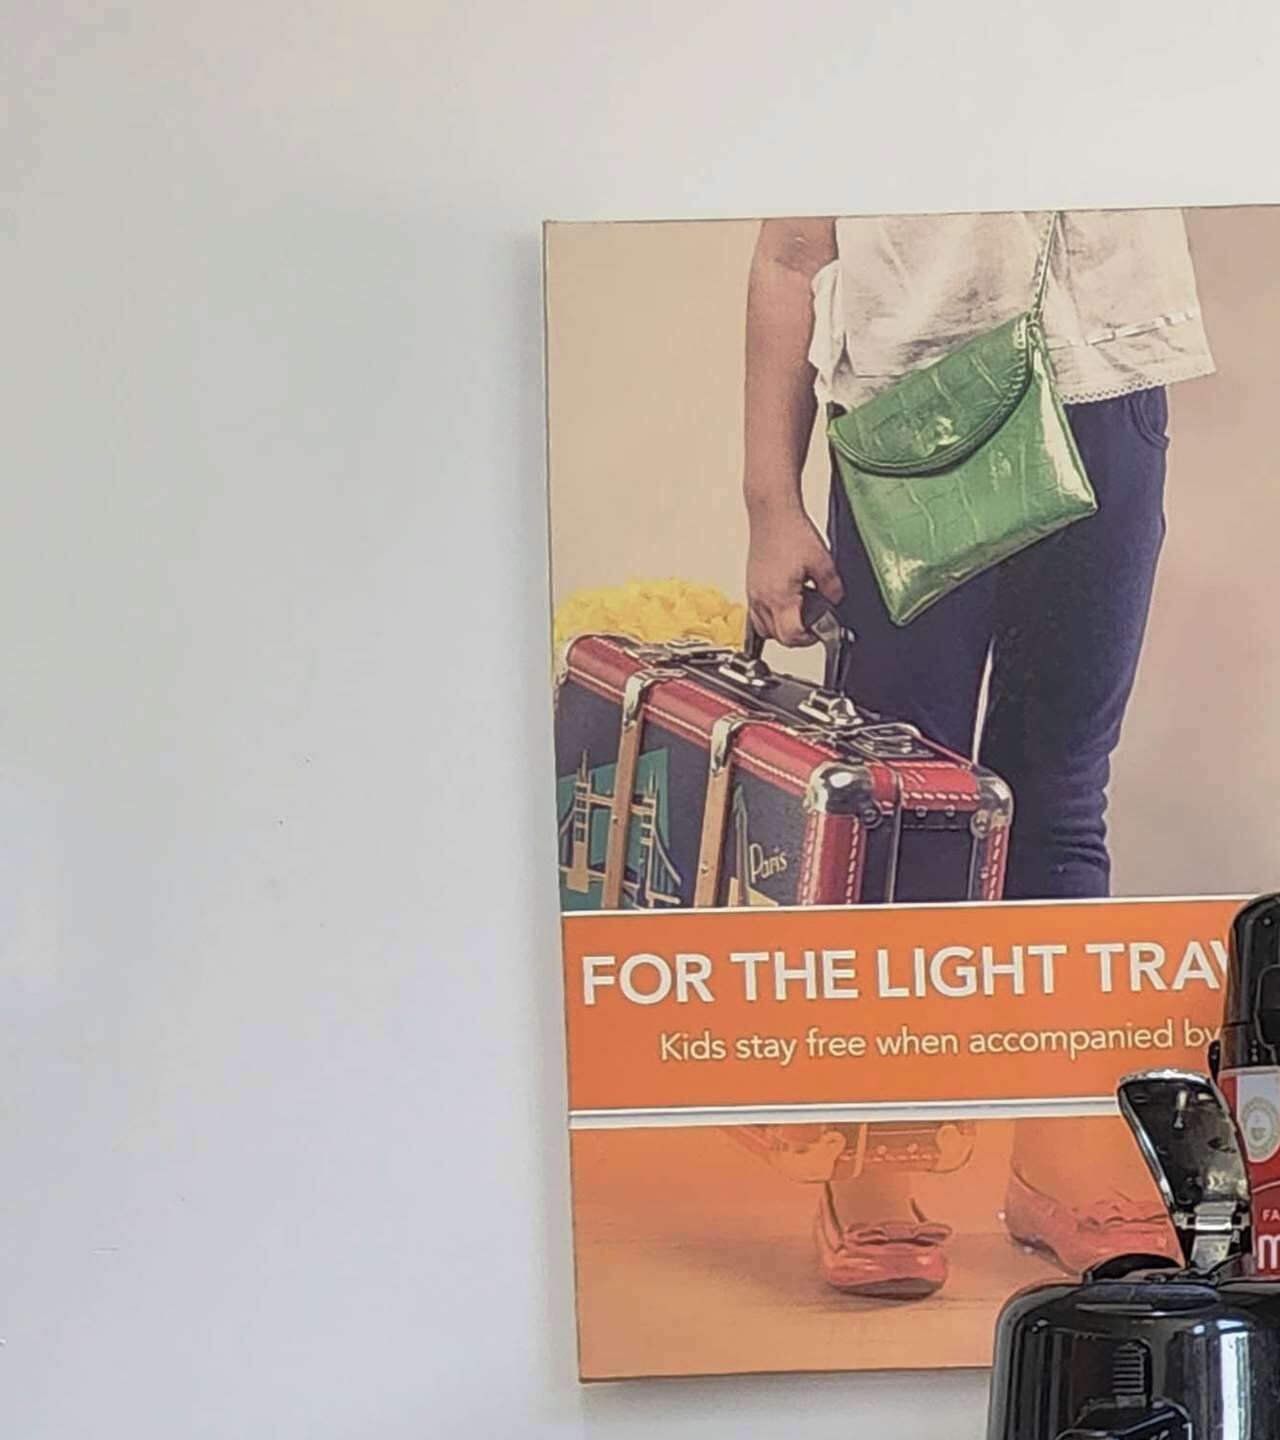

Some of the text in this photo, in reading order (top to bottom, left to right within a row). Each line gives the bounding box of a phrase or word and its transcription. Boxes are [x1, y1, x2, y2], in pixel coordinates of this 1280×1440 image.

[749, 843, 788, 882] Paris
[581, 954, 714, 1005] FOR
[731, 949, 858, 1001] THE
[878, 944, 1066, 998] LIGHT
[661, 1031, 726, 1062] Kids
[735, 1031, 797, 1067] stay
[806, 1026, 866, 1057] free
[876, 1025, 958, 1056] when
[969, 1020, 1175, 1067] accompanied
